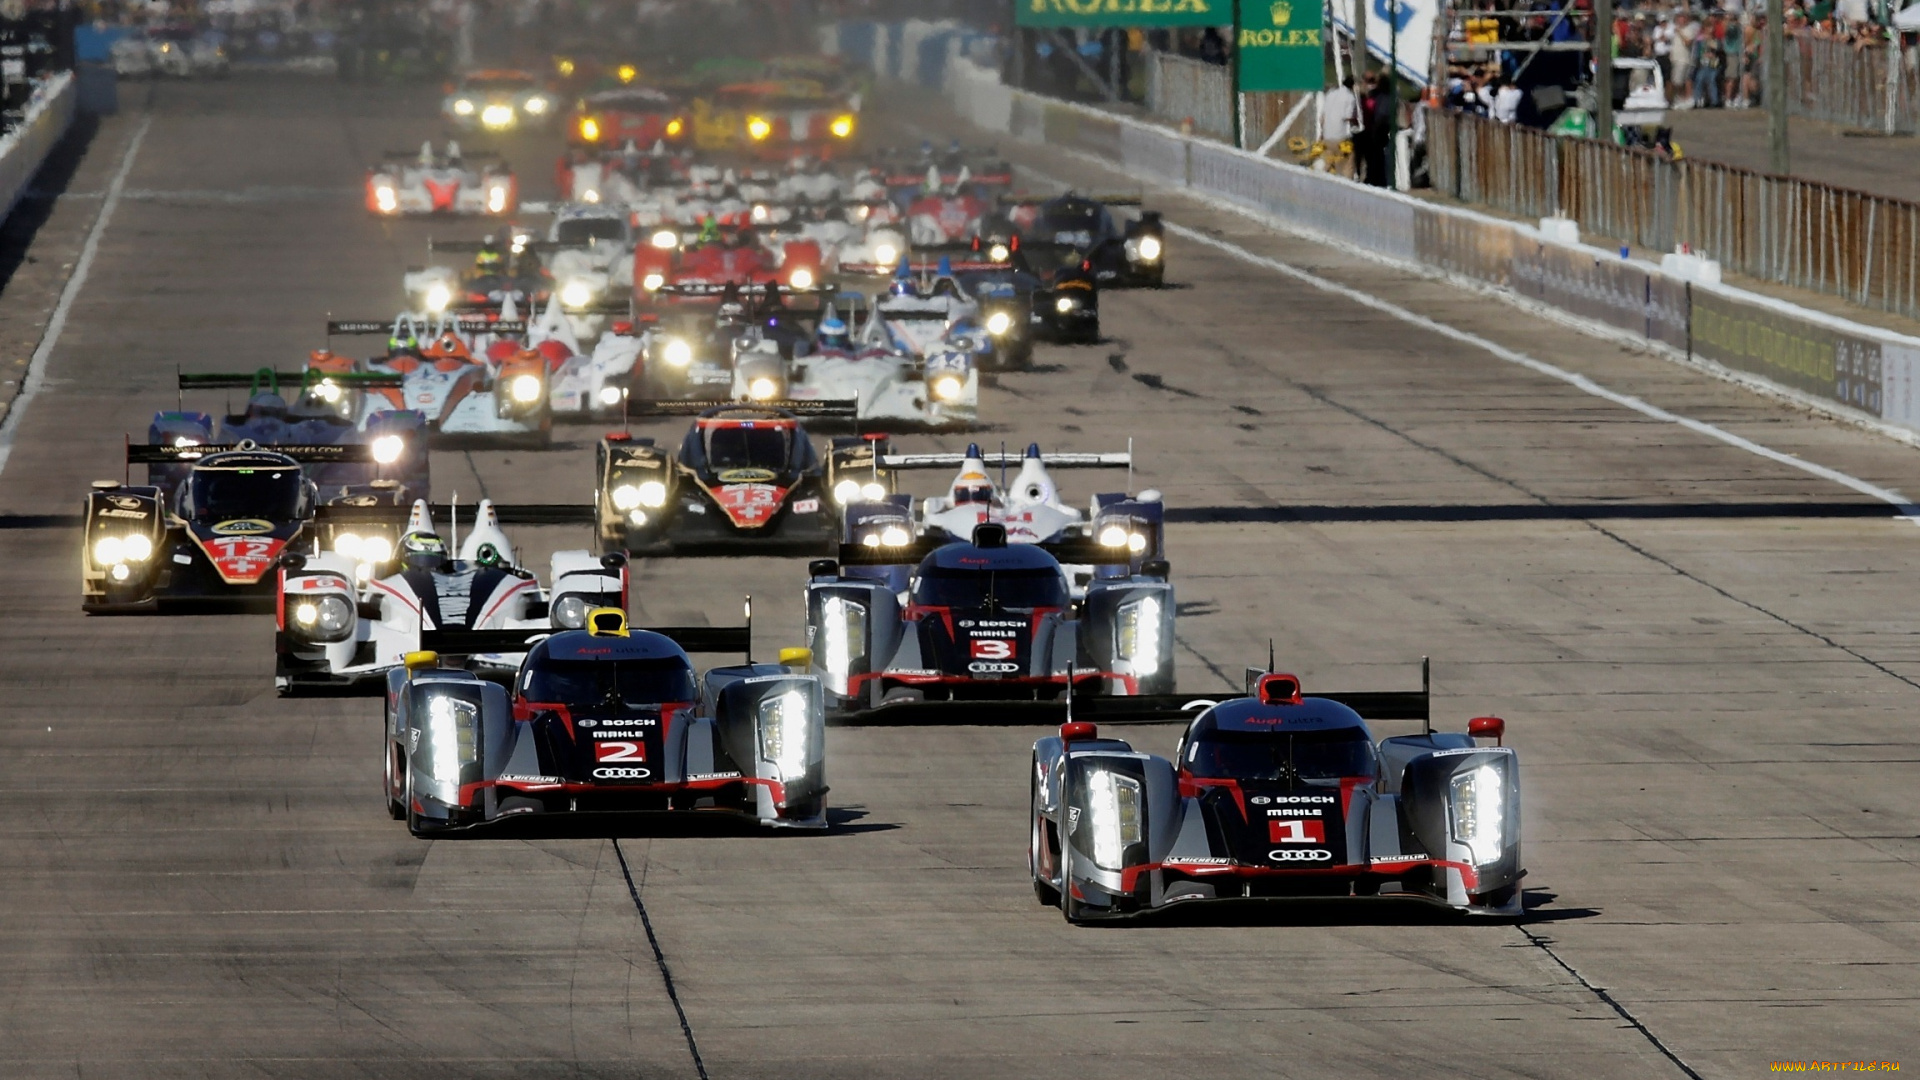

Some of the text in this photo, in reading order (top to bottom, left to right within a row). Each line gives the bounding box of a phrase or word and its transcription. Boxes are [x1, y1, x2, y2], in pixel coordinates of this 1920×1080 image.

[1238, 28, 1320, 47] ROLEX
[729, 490, 774, 504] 13
[98, 508, 148, 519] LEMO
[219, 542, 269, 558] 12
[969, 630, 1017, 638] MAHLE
[975, 640, 1012, 659] 3
[1244, 716, 1283, 724] Audi
[593, 730, 644, 738] MAHLE
[599, 742, 643, 762] 2
[513, 774, 556, 783] MICHELIN
[696, 771, 738, 780] MICHELIN
[1276, 796, 1335, 804] BOSCH
[1278, 820, 1317, 843] 1
[1180, 857, 1227, 865] MICHELIN
[1380, 853, 1425, 862] MICHELIN
